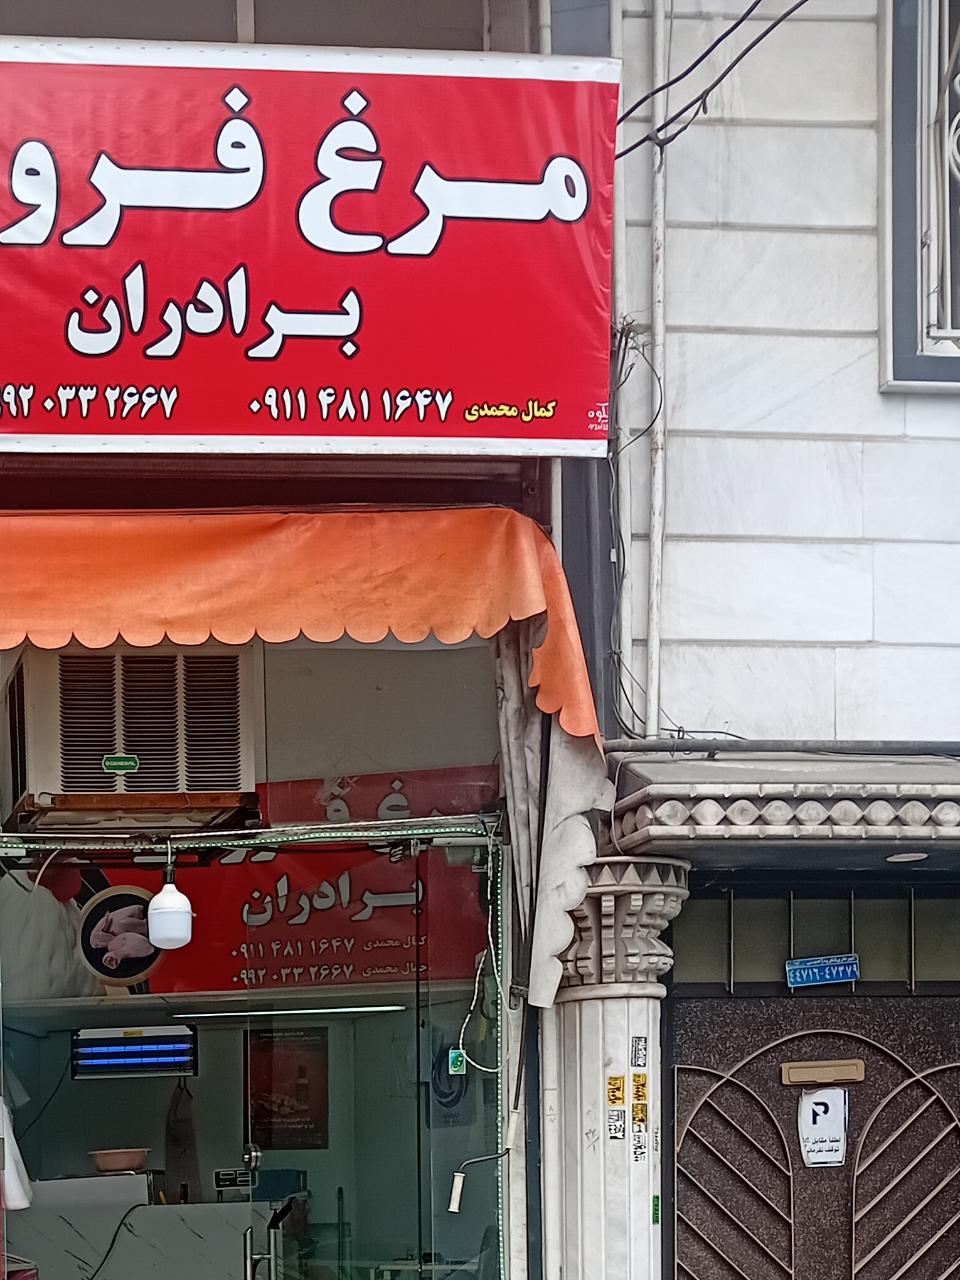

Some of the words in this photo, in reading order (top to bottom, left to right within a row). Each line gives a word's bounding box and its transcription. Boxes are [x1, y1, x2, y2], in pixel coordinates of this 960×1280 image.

[296, 88, 590, 257] مرغ
[65, 260, 363, 360] برادران
[43, 384, 98, 419] ۰۳۳
[104, 384, 179, 420] ۲۶۶۷
[249, 386, 307, 421] ۰۹۱۱
[317, 386, 370, 422] ۴۸۱
[381, 388, 454, 422] ۱۶۴۷
[464, 400, 519, 422] محمدی
[520, 398, 557, 423] کمال
[242, 870, 425, 926] برادران
[231, 942, 265, 961] ۰۹۱۱
[271, 939, 303, 958] ۴۸۱
[311, 937, 356, 956] ۱۶۴۷
[232, 966, 266, 984] ۰۹۹۲
[272, 965, 304, 982] ۰۳۳
[309, 963, 355, 982] ۲۶۶۷
[812, 1101, 830, 1126] P
